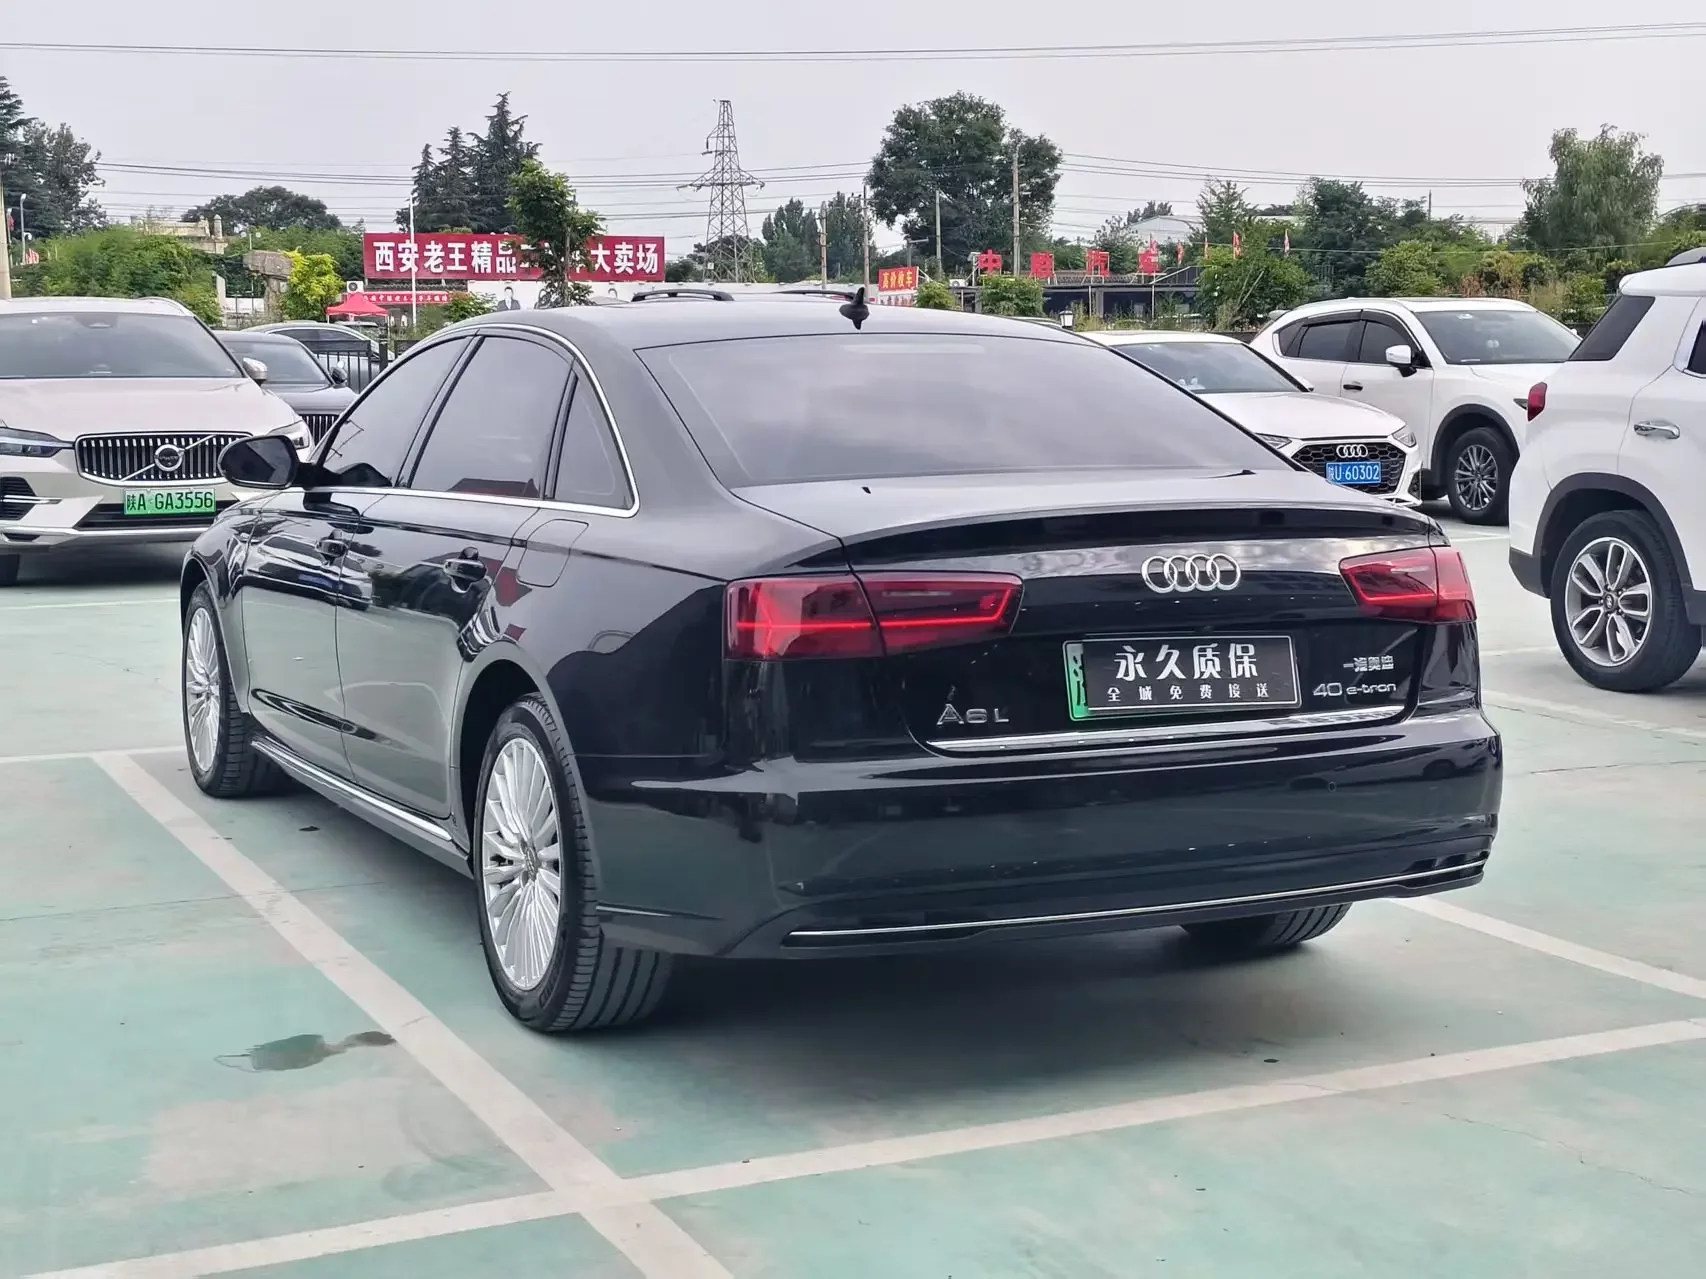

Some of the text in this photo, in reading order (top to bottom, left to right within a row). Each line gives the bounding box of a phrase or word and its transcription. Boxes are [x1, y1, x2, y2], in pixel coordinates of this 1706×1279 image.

[1114, 643, 1258, 682] 永久质保
[1107, 683, 1270, 702] 全城免费接送
[1313, 682, 1397, 697] 40 e-tron
